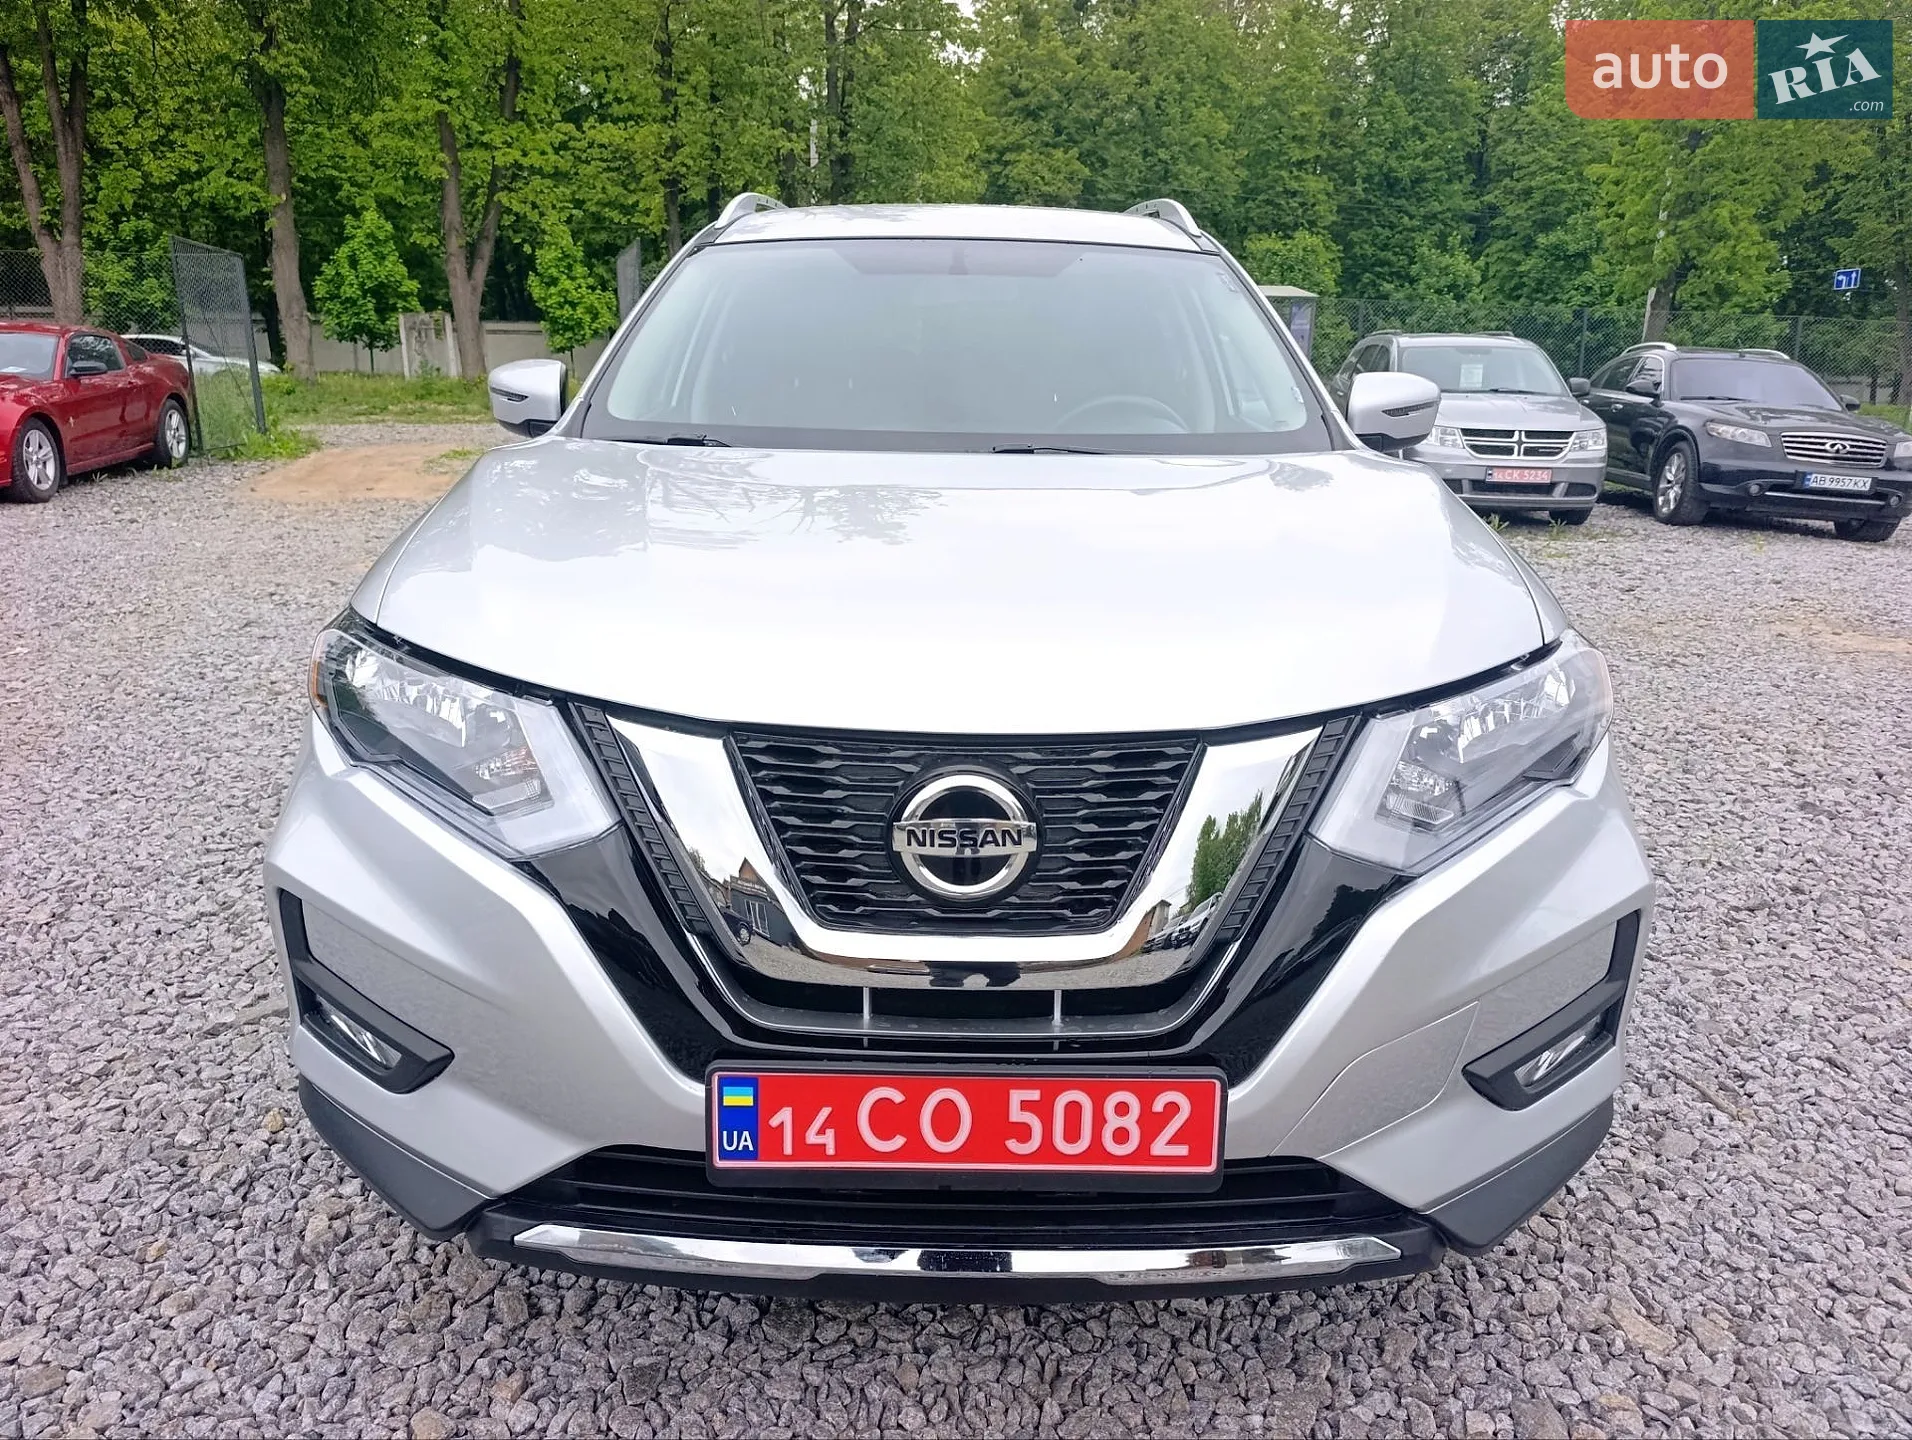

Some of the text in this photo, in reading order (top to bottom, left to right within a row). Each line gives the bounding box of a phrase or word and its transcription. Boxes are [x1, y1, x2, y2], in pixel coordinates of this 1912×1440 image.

[906, 829, 1022, 848] NISSAN
[768, 1086, 1192, 1157] 14 CO 5082
[722, 1130, 754, 1152] UA
